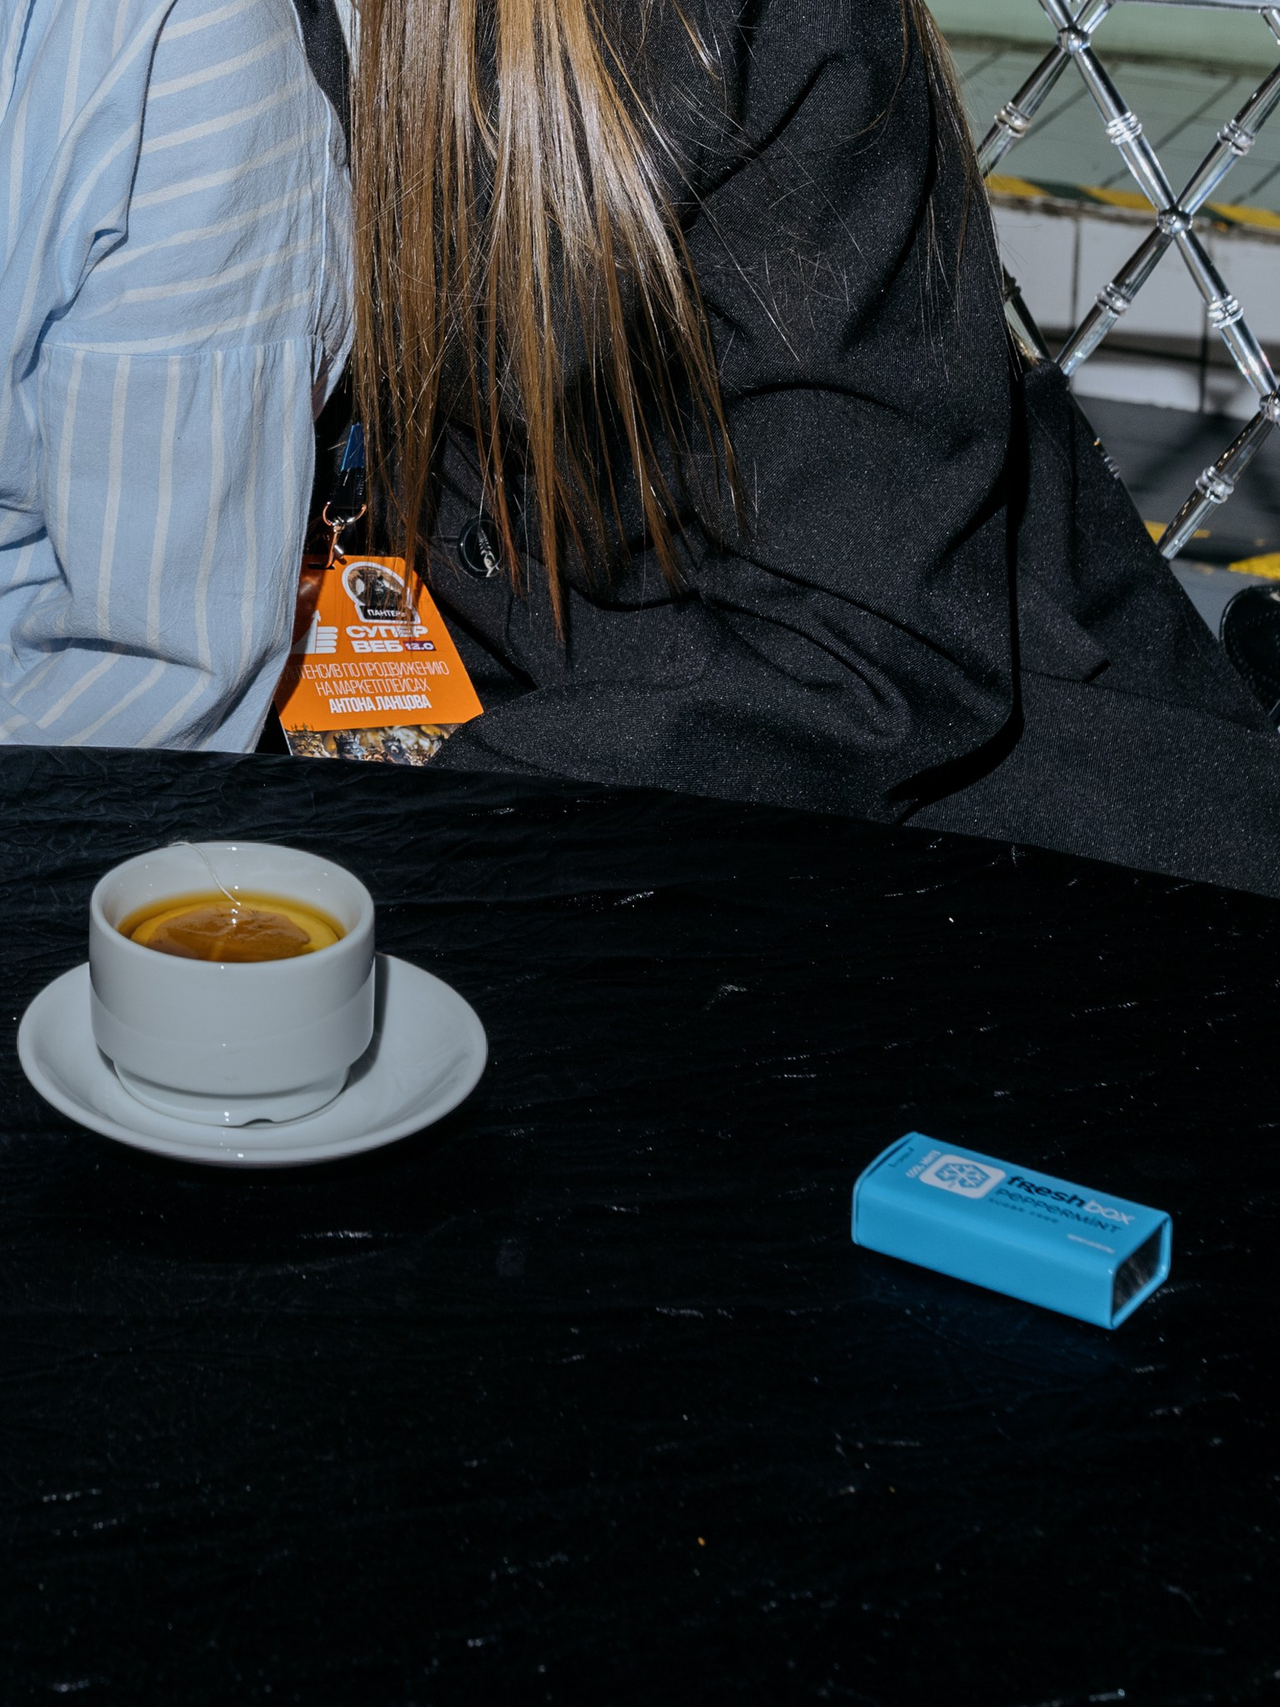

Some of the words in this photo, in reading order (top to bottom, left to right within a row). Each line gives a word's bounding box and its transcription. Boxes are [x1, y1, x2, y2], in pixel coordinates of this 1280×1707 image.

[345, 625, 429, 639] СУПЕР
[351, 639, 404, 653] ВЕБ
[404, 642, 435, 652] 12.0
[342, 662, 360, 678] ПО
[358, 660, 450, 678] ПРОДВИЖЕНИЮ
[314, 681, 336, 696] НА
[328, 696, 376, 714] АНТОНА
[375, 694, 432, 711] ЛАНЦОВА
